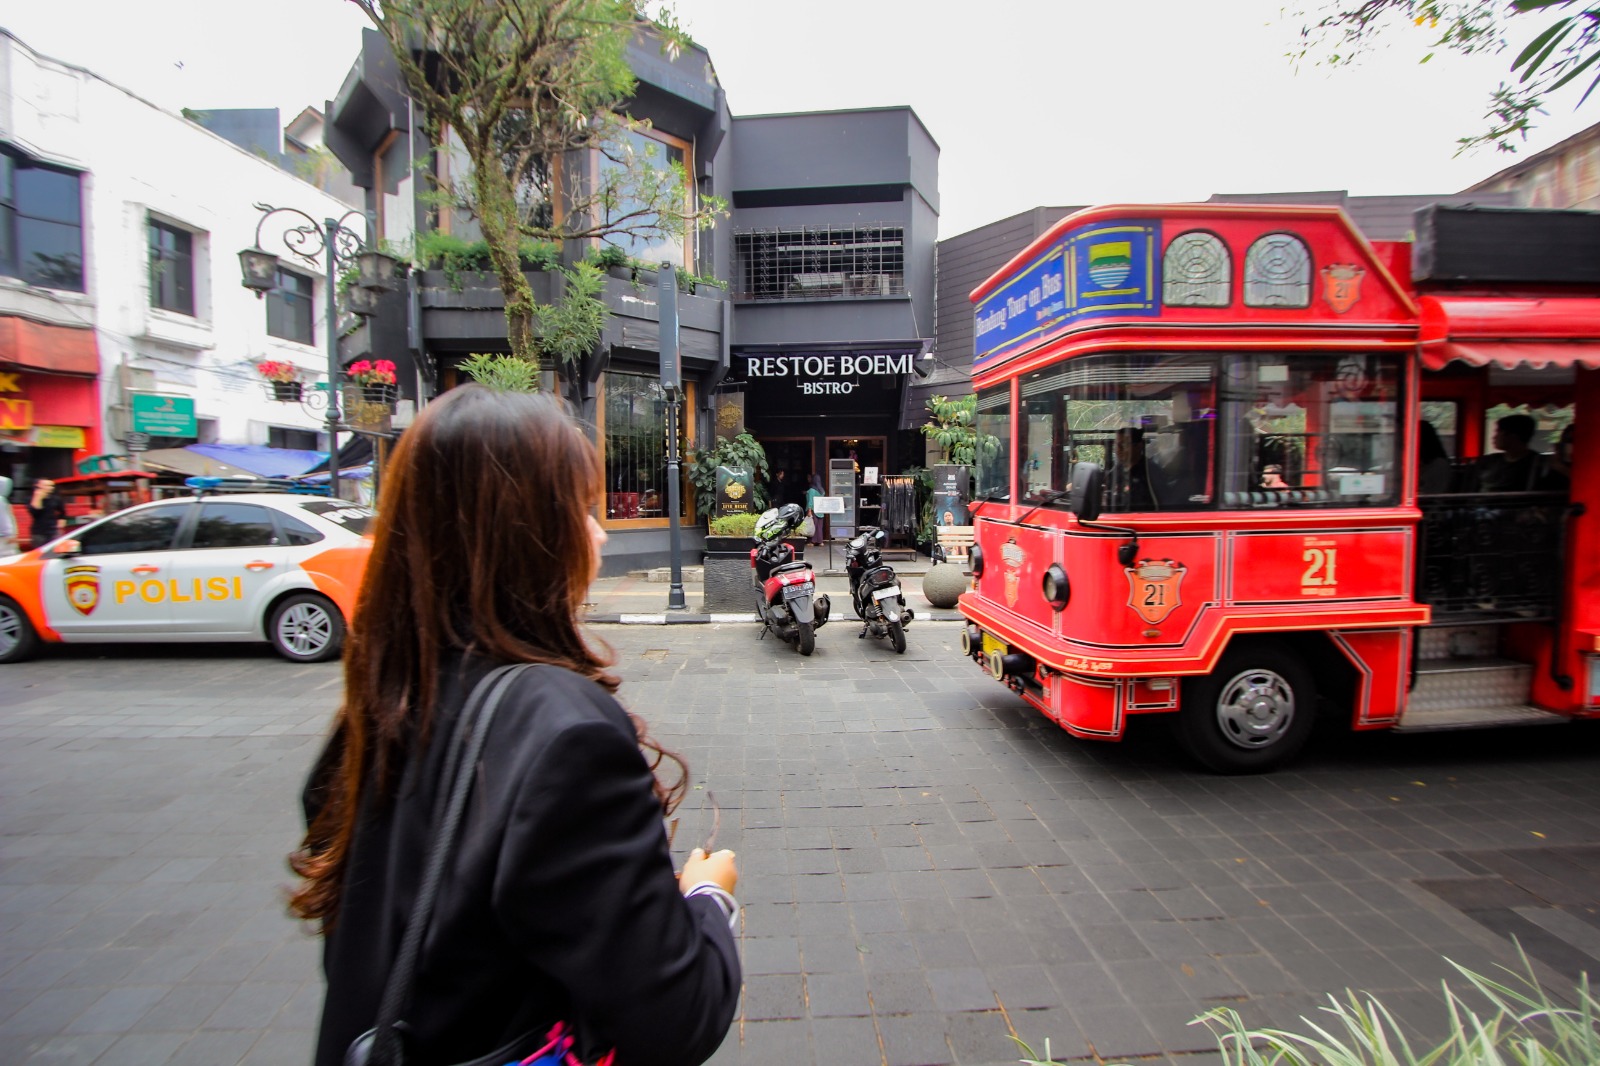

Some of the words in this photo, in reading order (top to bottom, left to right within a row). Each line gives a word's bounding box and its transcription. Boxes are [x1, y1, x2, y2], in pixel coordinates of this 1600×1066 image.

[1334, 281, 1349, 298] 21
[976, 307, 1007, 337] Bandung
[1006, 294, 1028, 319] Tour
[1028, 286, 1042, 308] on
[1041, 272, 1063, 299] Bus
[747, 356, 834, 377] RESTOE
[840, 354, 914, 376] BOEMI
[803, 382, 853, 395] BISTRO
[1301, 548, 1338, 586] 21
[114, 576, 243, 605] POLISI
[1143, 583, 1167, 607] 21
